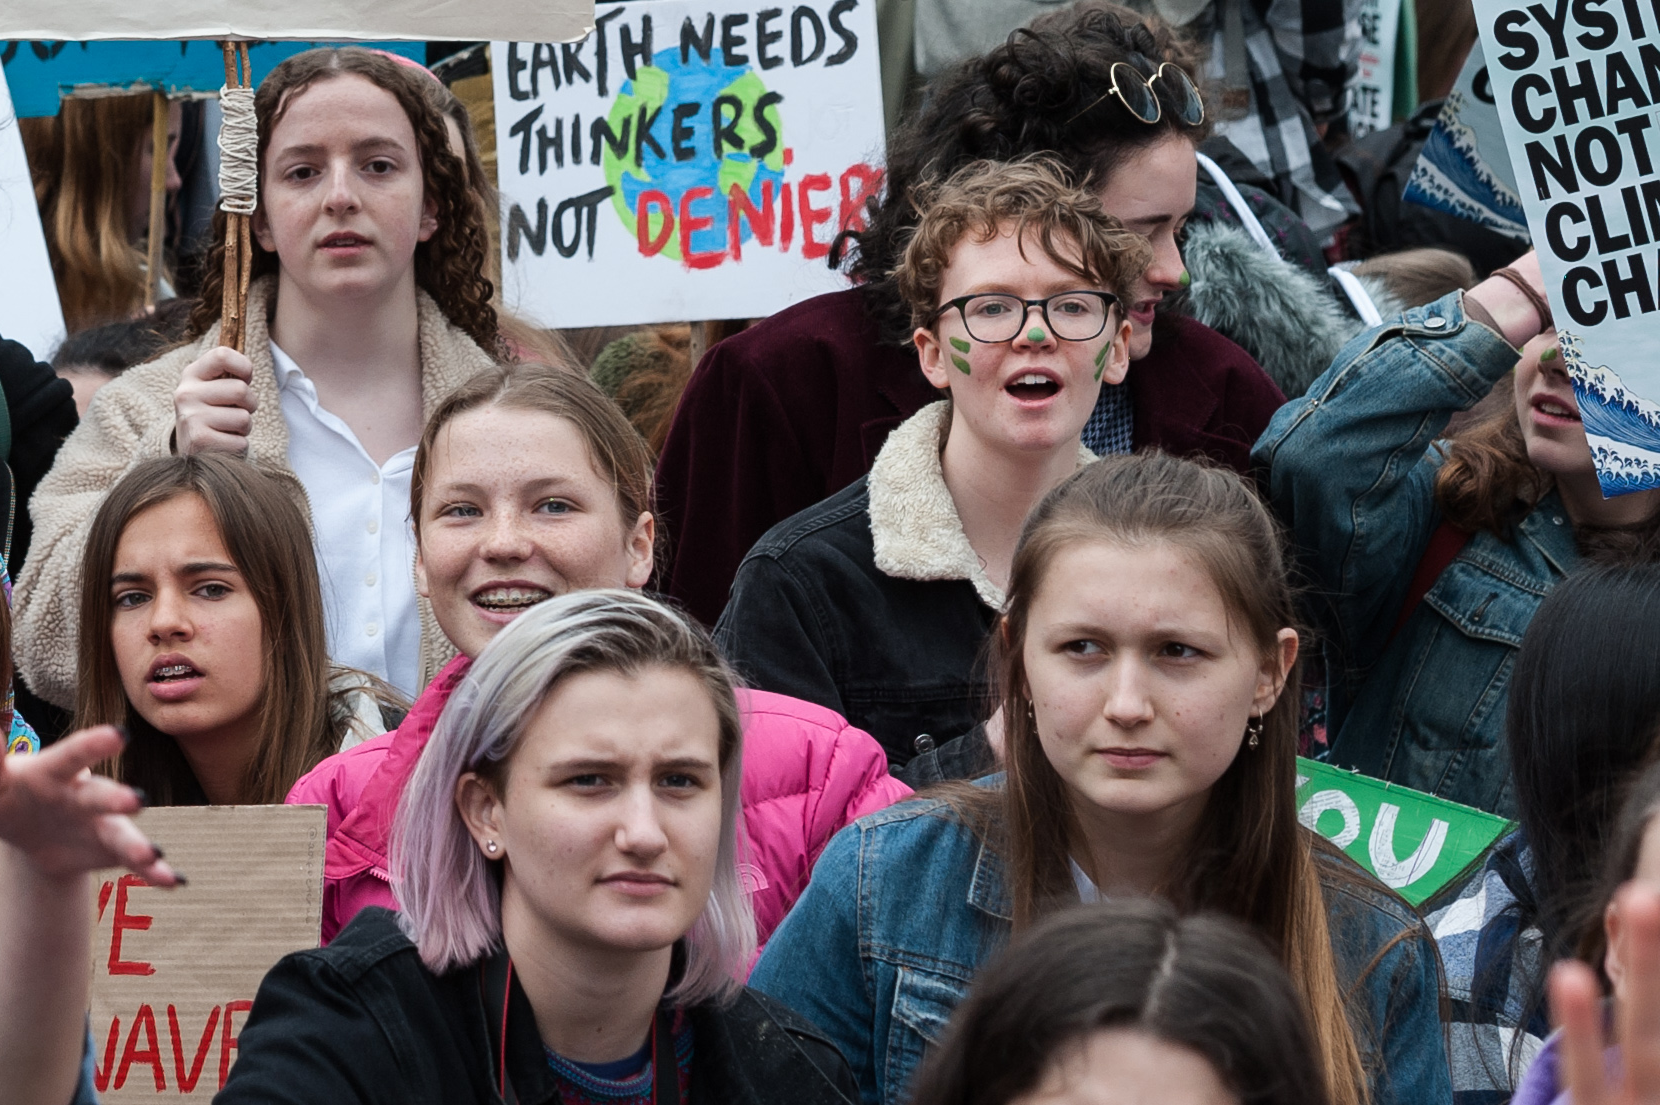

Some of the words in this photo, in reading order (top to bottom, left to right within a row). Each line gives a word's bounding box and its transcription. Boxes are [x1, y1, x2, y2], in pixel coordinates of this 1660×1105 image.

[507, 6, 655, 102] EARTH
[509, 90, 785, 177] THINKERS
[1524, 113, 1654, 202] NOT
[506, 186, 616, 263] NOT
[1296, 773, 1449, 889] OU
